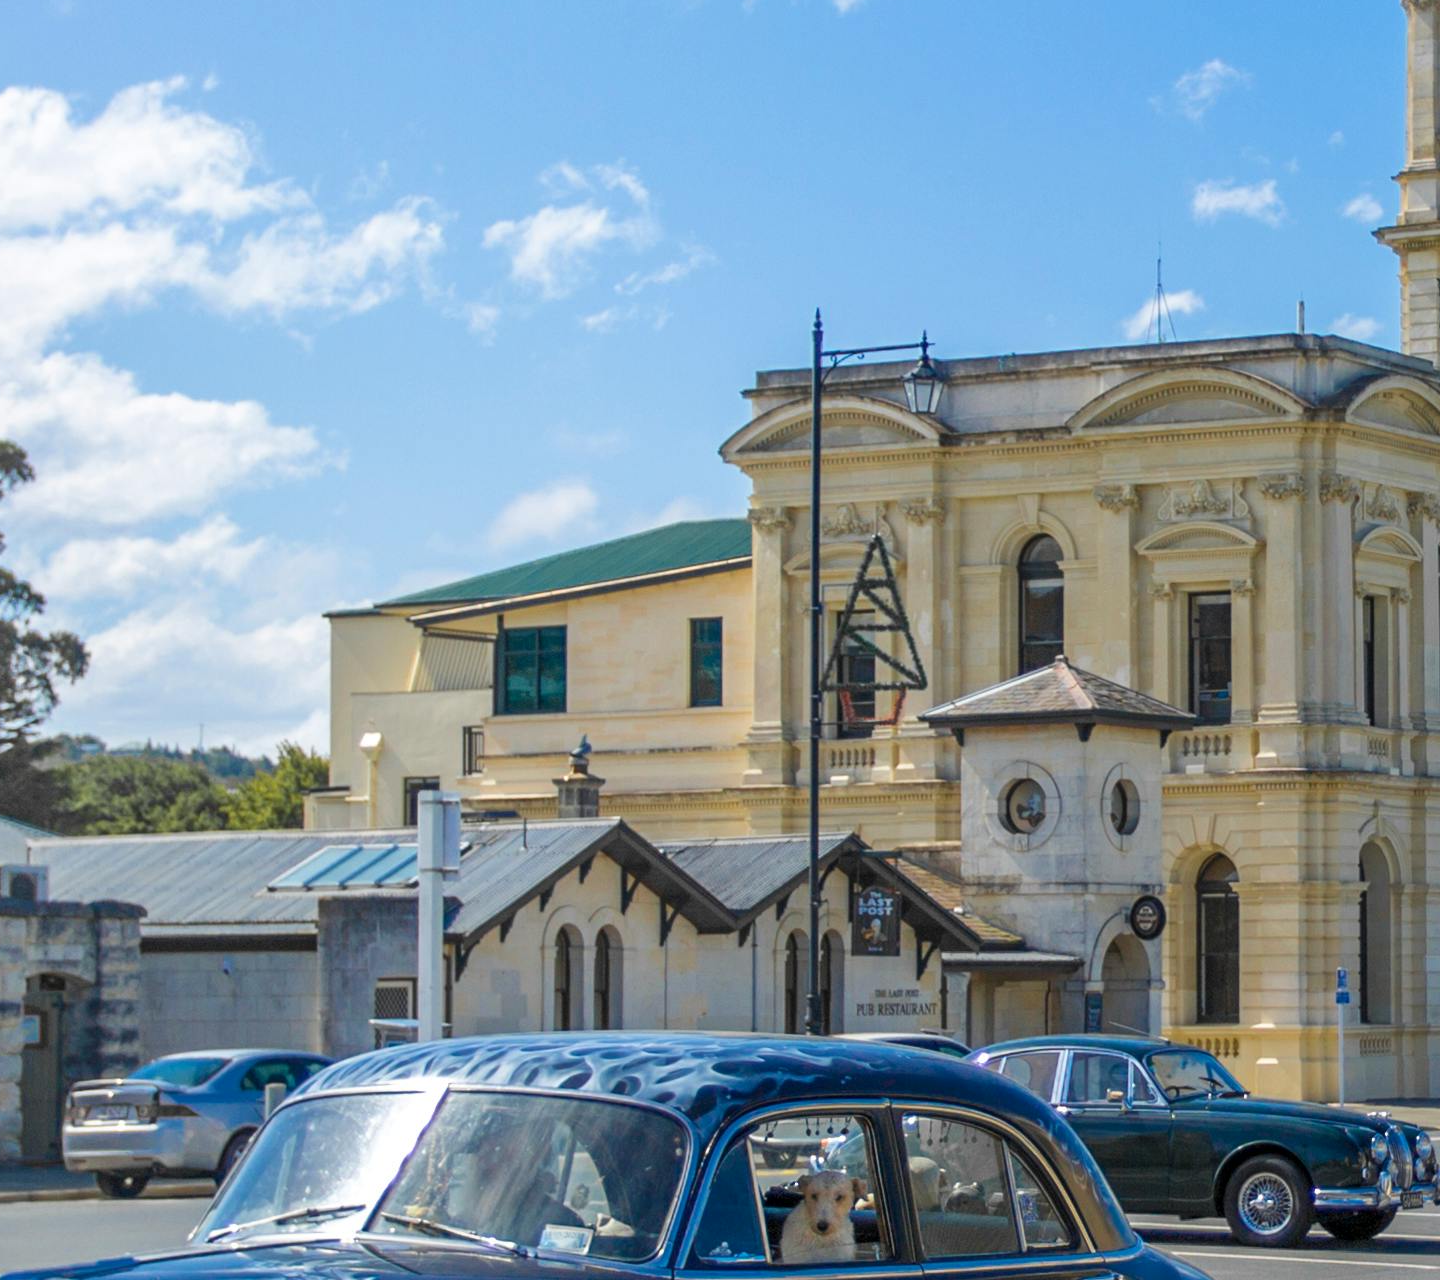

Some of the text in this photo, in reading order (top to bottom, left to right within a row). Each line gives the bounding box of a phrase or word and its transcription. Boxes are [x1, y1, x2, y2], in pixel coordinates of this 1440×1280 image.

[858, 898, 894, 907] LAST
[858, 906, 893, 916] POST
[856, 1002, 937, 1016] PUB RESTAURANT
